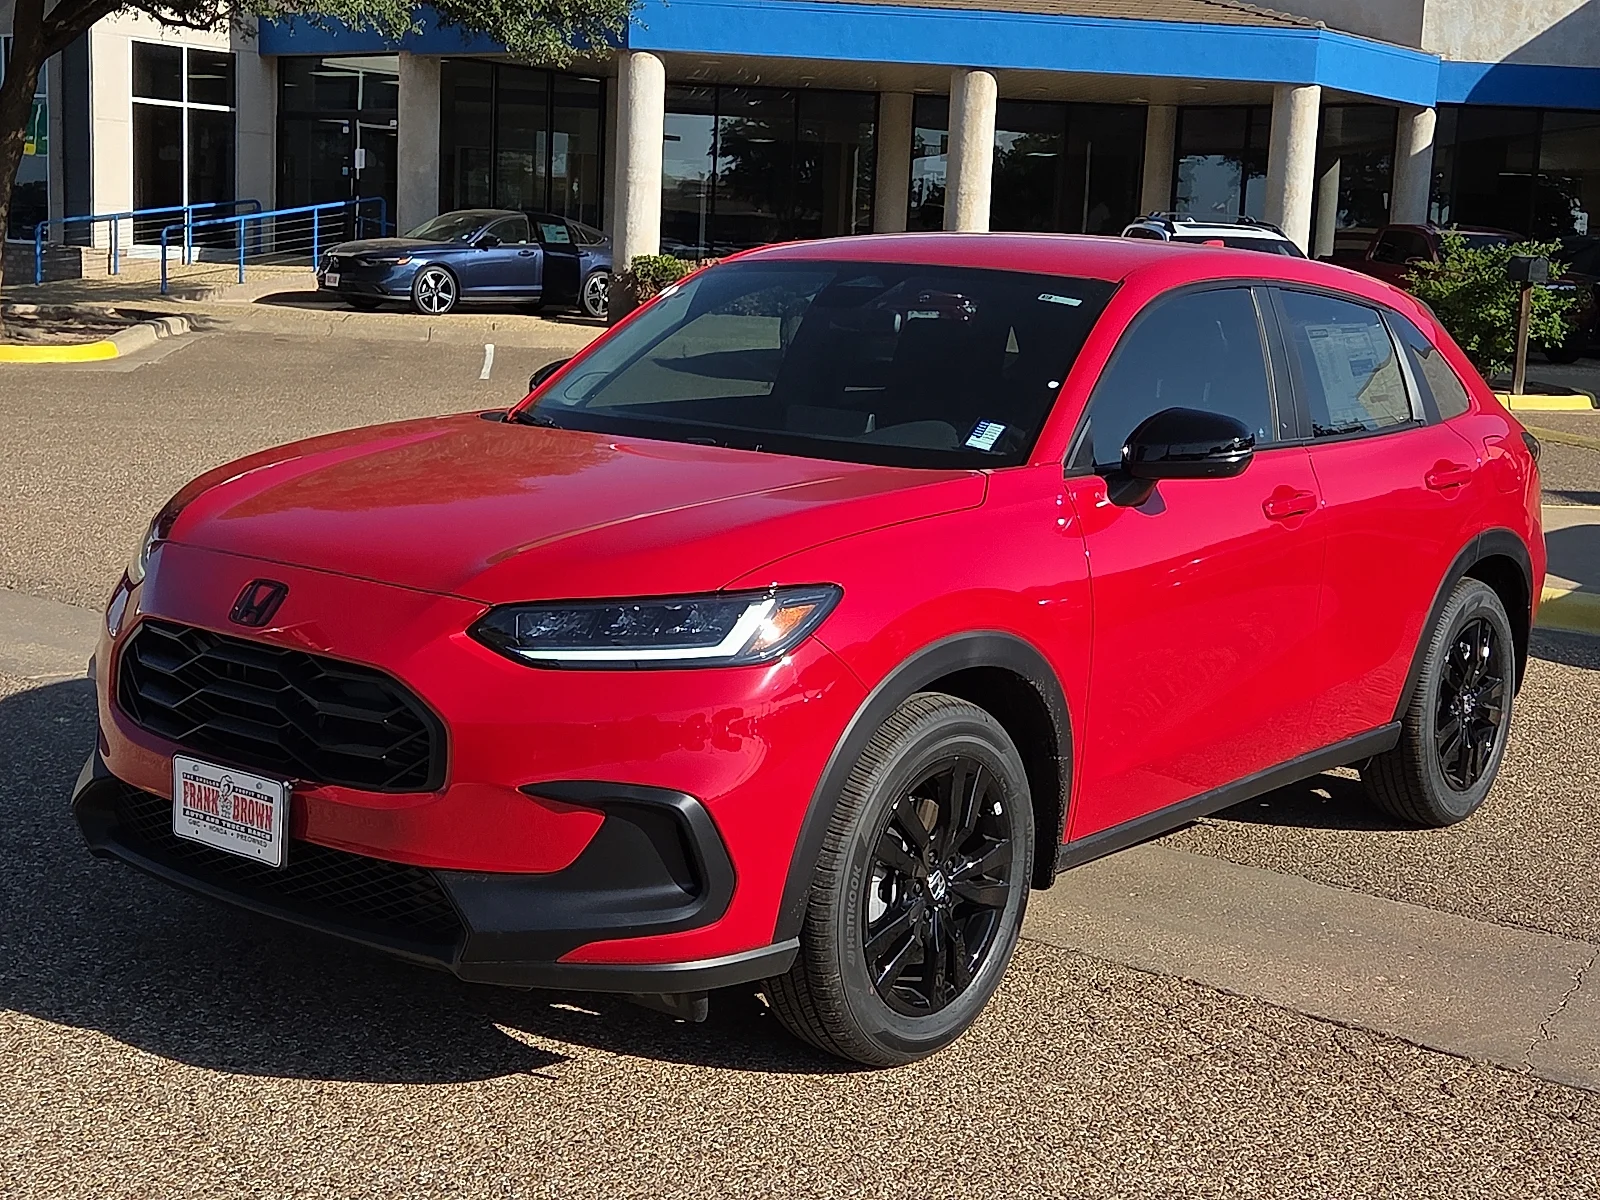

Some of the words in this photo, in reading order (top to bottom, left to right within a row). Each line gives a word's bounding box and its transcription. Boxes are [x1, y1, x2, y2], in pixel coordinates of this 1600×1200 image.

[183, 781, 220, 816] FRANK
[232, 795, 273, 832] BROWN
[185, 810, 204, 820] AUTO
[206, 816, 219, 825] AND
[221, 820, 246, 832] TRUCK
[247, 828, 271, 840] RANCH
[188, 818, 201, 828] GMC
[209, 825, 227, 836] HONDA
